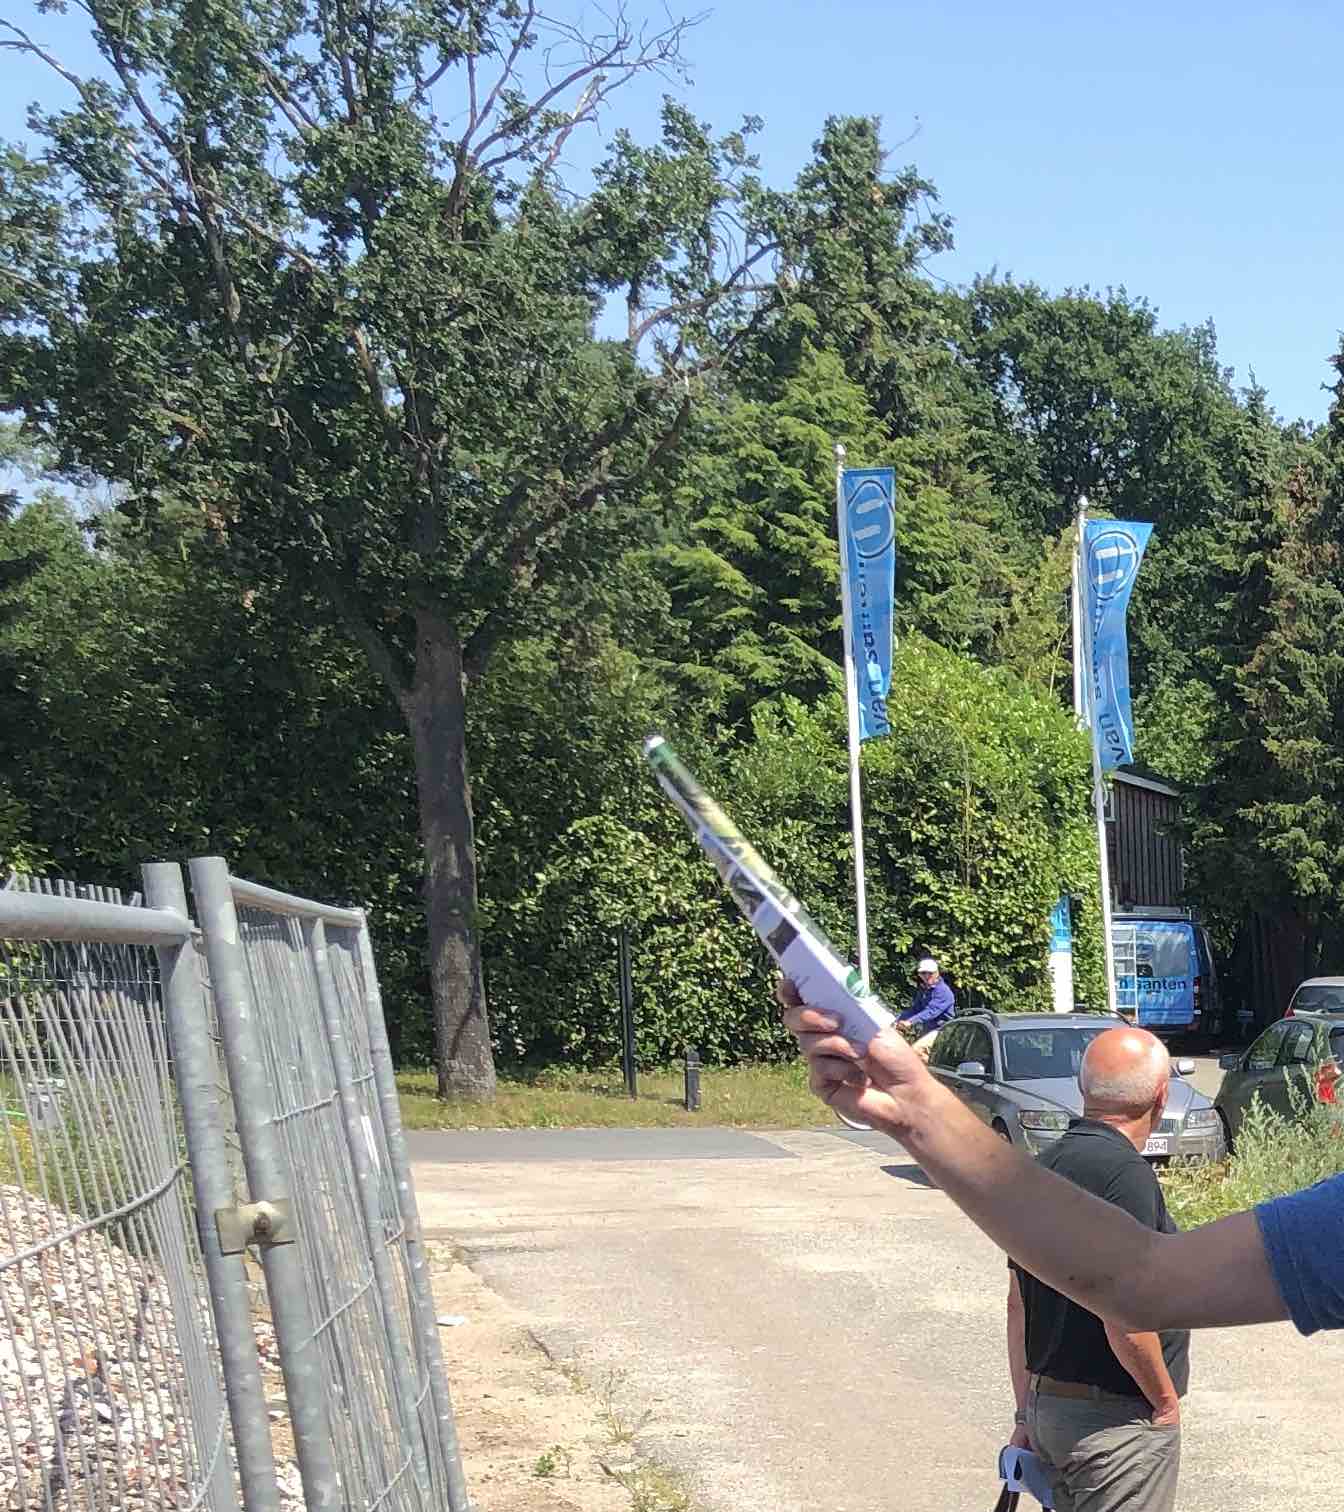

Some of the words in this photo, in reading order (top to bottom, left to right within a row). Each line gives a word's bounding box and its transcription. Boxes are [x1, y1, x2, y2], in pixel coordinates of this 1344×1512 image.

[1098, 713, 1125, 762] van
[1136, 977, 1187, 990] santen
[1147, 1141, 1167, 1152] 894
